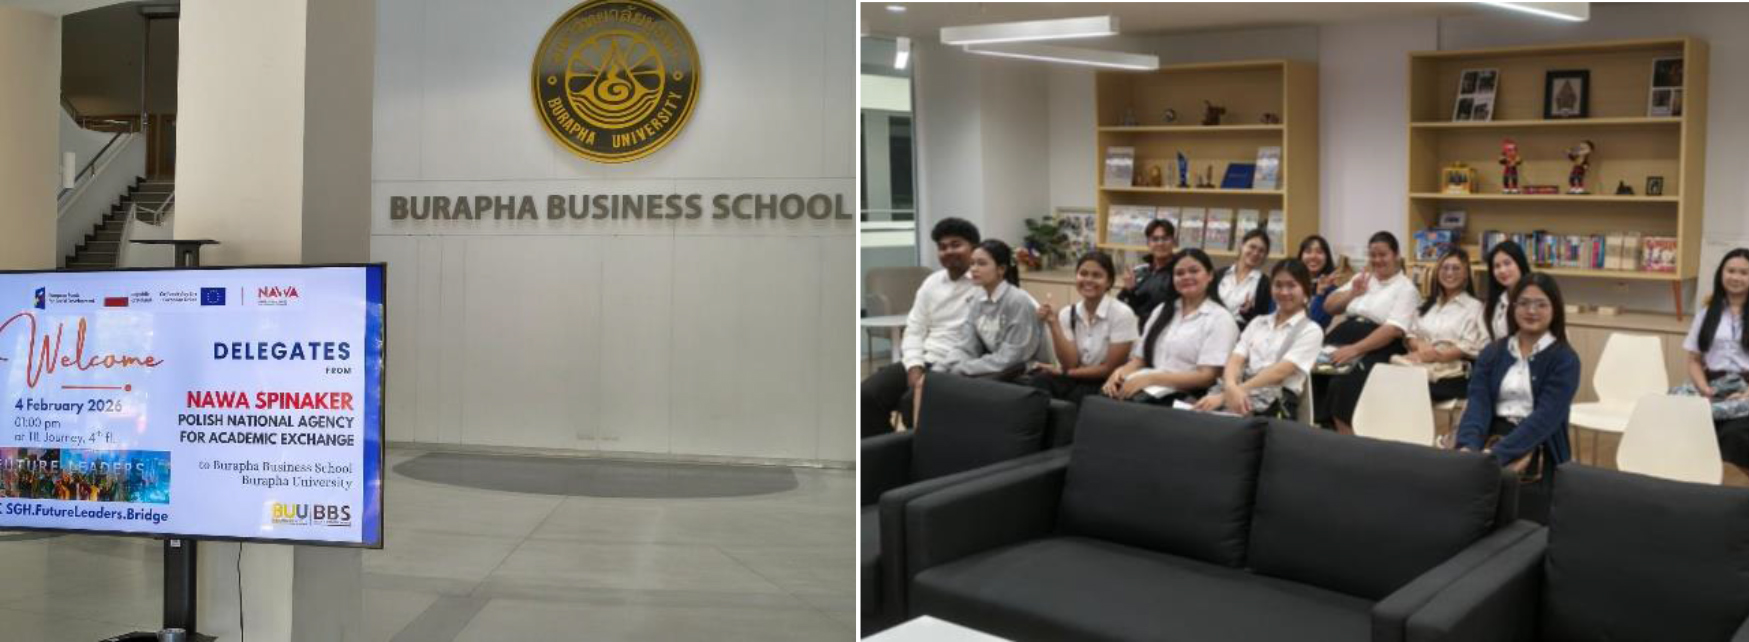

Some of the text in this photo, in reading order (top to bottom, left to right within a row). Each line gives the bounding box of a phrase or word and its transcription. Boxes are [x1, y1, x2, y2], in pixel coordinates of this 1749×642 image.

[547, 91, 683, 148] BURAPHA UNIVERSITY
[390, 194, 853, 220] BURAPHA BUSINESS SCHOOL
[258, 286, 299, 298] NAWA
[0, 312, 164, 388] Welcome
[213, 342, 351, 360] DELEGATES
[14, 399, 122, 414] 4 February 2026
[187, 391, 354, 410] NAWA SPINAKER
[14, 417, 61, 430] 01:00 pm
[178, 414, 355, 428] POLISH NATIONAL AGENCY
[180, 431, 355, 446] FOR ACADEMIC EXCHANGE
[69, 461, 145, 475] LEADERS
[213, 460, 259, 472] Burapha
[262, 461, 312, 472] Business
[314, 462, 352, 474] School
[242, 475, 353, 490] Burapha University
[6, 503, 168, 525] SGH.FutureLeaders.Bridge
[313, 505, 351, 521] BBS
